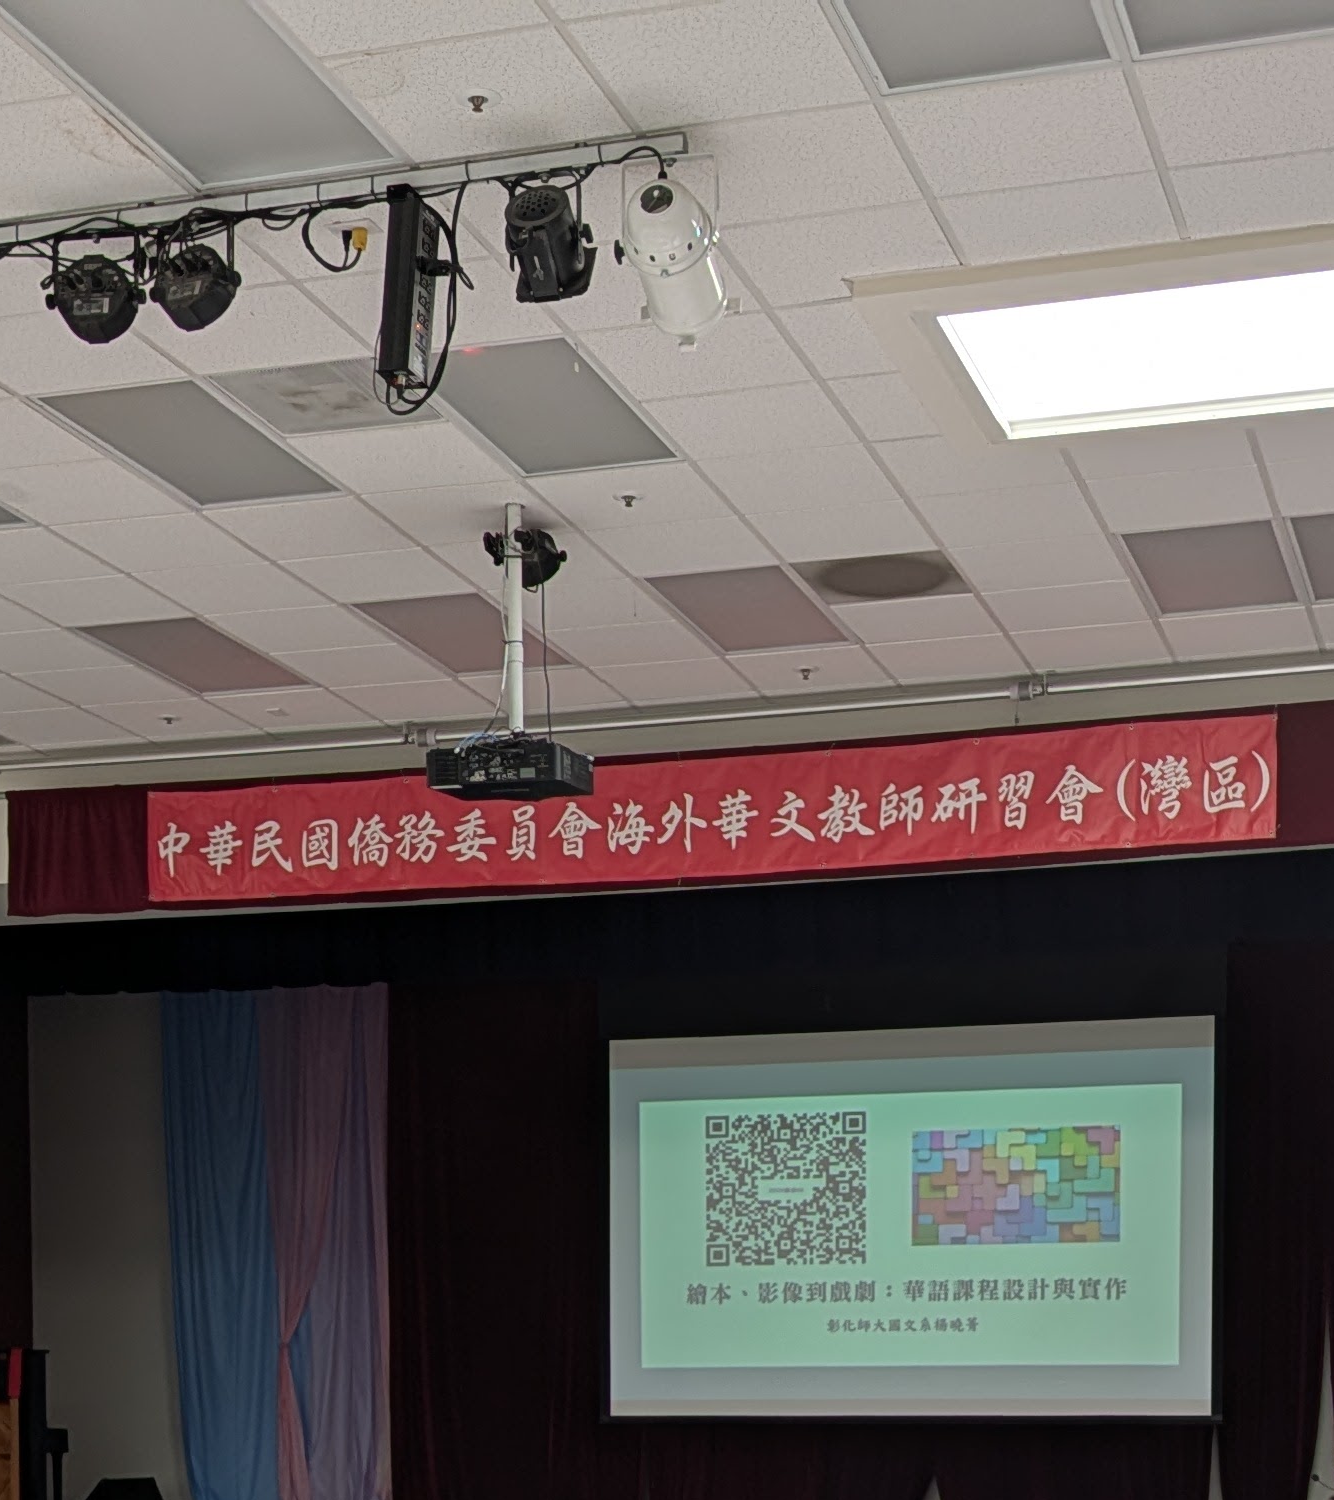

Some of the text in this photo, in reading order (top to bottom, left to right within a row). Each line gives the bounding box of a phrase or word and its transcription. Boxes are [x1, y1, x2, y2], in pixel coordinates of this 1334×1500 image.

[157, 750, 1271, 878] 中華民國僑務委員會海外華文教師研習會(灣區)
